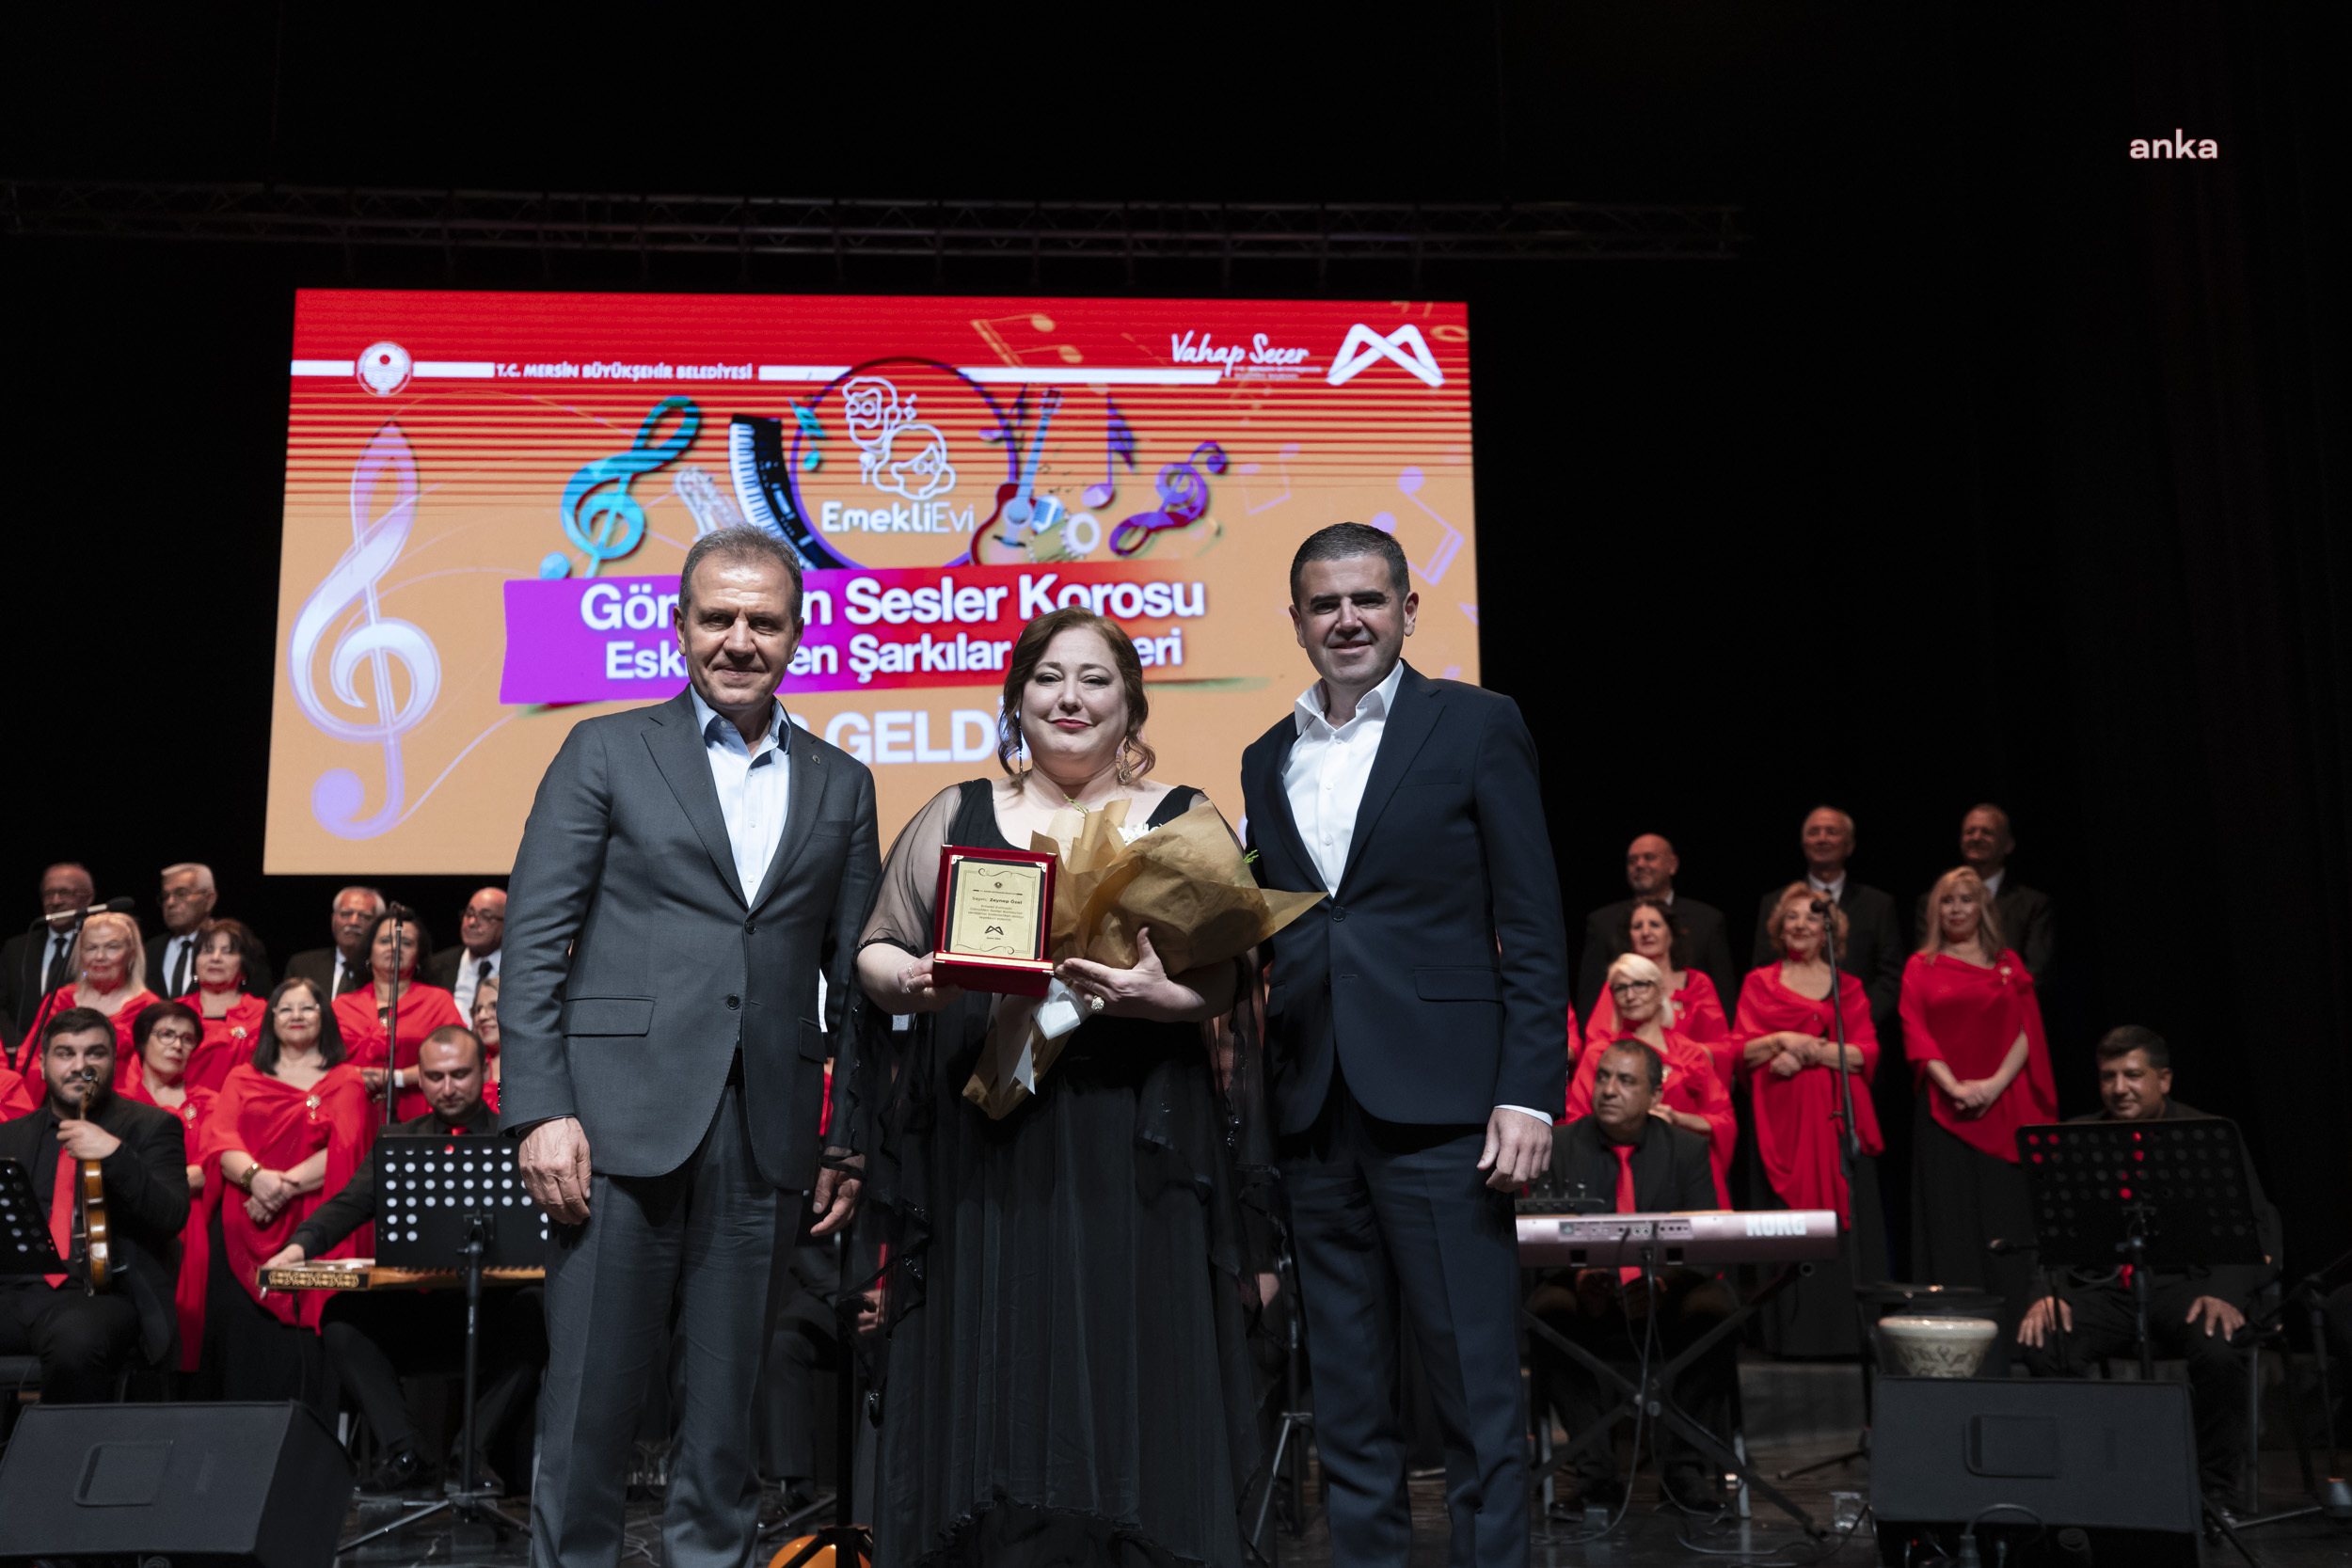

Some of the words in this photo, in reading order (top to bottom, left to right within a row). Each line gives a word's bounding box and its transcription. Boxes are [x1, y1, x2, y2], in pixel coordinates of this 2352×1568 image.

[497, 363, 521, 377] T.C.
[523, 361, 580, 378] MERSİN
[581, 361, 674, 382] BÜYÜKŞEHİR
[675, 362, 753, 380] BELEDİYESİ
[1171, 329, 1247, 377] Vahap
[821, 500, 975, 533] EmekliEvi
[845, 577, 1009, 625] Sesler
[1019, 573, 1205, 620] Korosu
[848, 632, 1012, 684] Şarkılar
[1745, 1214, 1807, 1237] KORG
